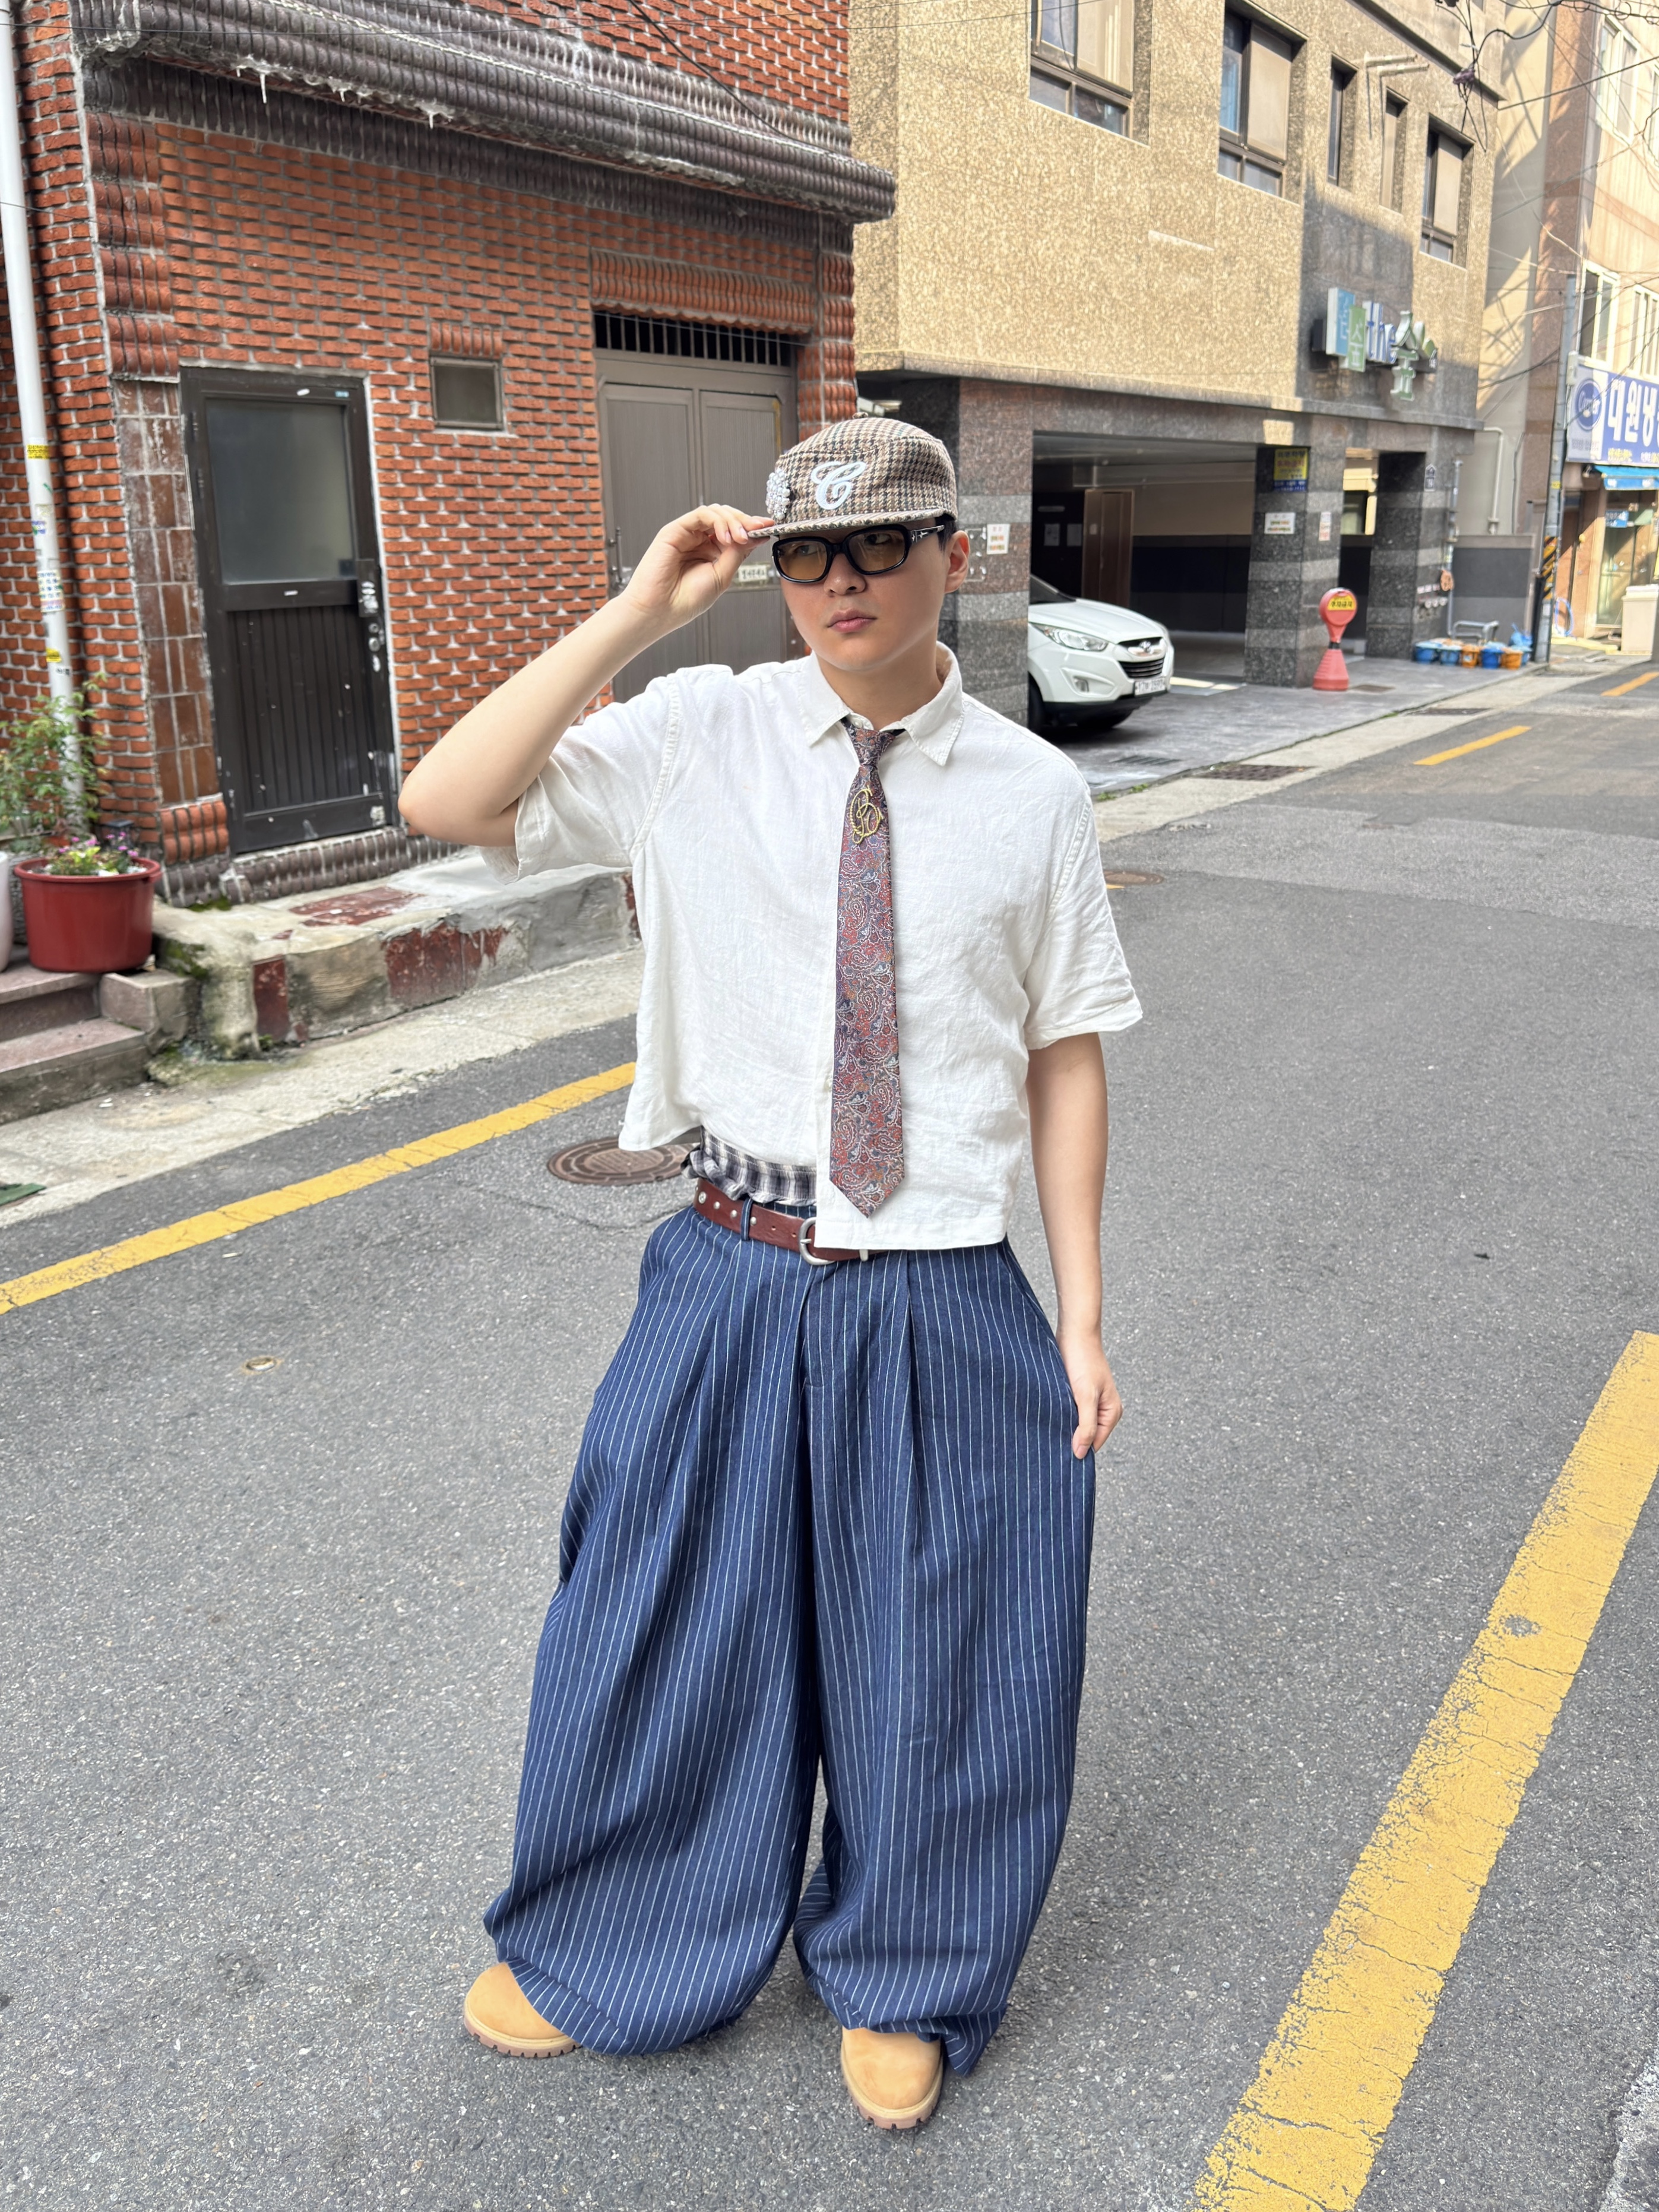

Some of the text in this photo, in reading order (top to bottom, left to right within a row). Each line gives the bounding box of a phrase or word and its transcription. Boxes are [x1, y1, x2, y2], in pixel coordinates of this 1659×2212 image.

[1366, 301, 1395, 364] the
[1608, 378, 1659, 447] 대원냉
[810, 460, 867, 510] C
